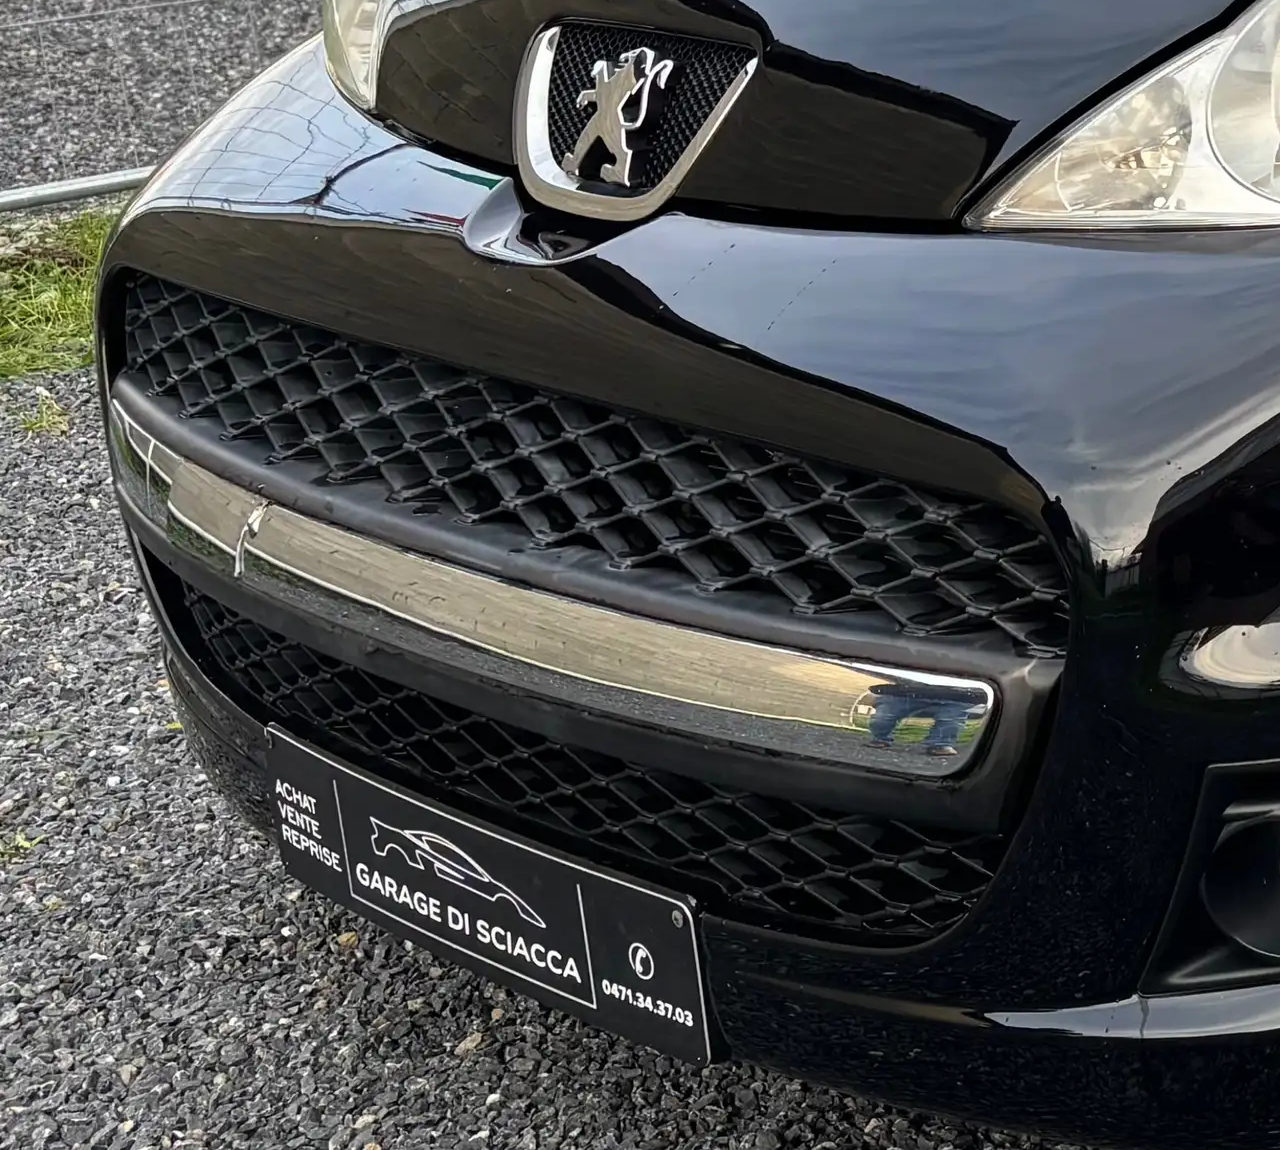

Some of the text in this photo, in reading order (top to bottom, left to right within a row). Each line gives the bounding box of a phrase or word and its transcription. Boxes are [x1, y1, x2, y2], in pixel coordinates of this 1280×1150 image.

[274, 778, 317, 815] ACHAT
[276, 800, 323, 840] VENTE
[281, 823, 343, 872] REPRISE
[355, 862, 582, 984] GARAGE DI SCIACCA
[601, 977, 694, 1028] 0471.34.37.03
